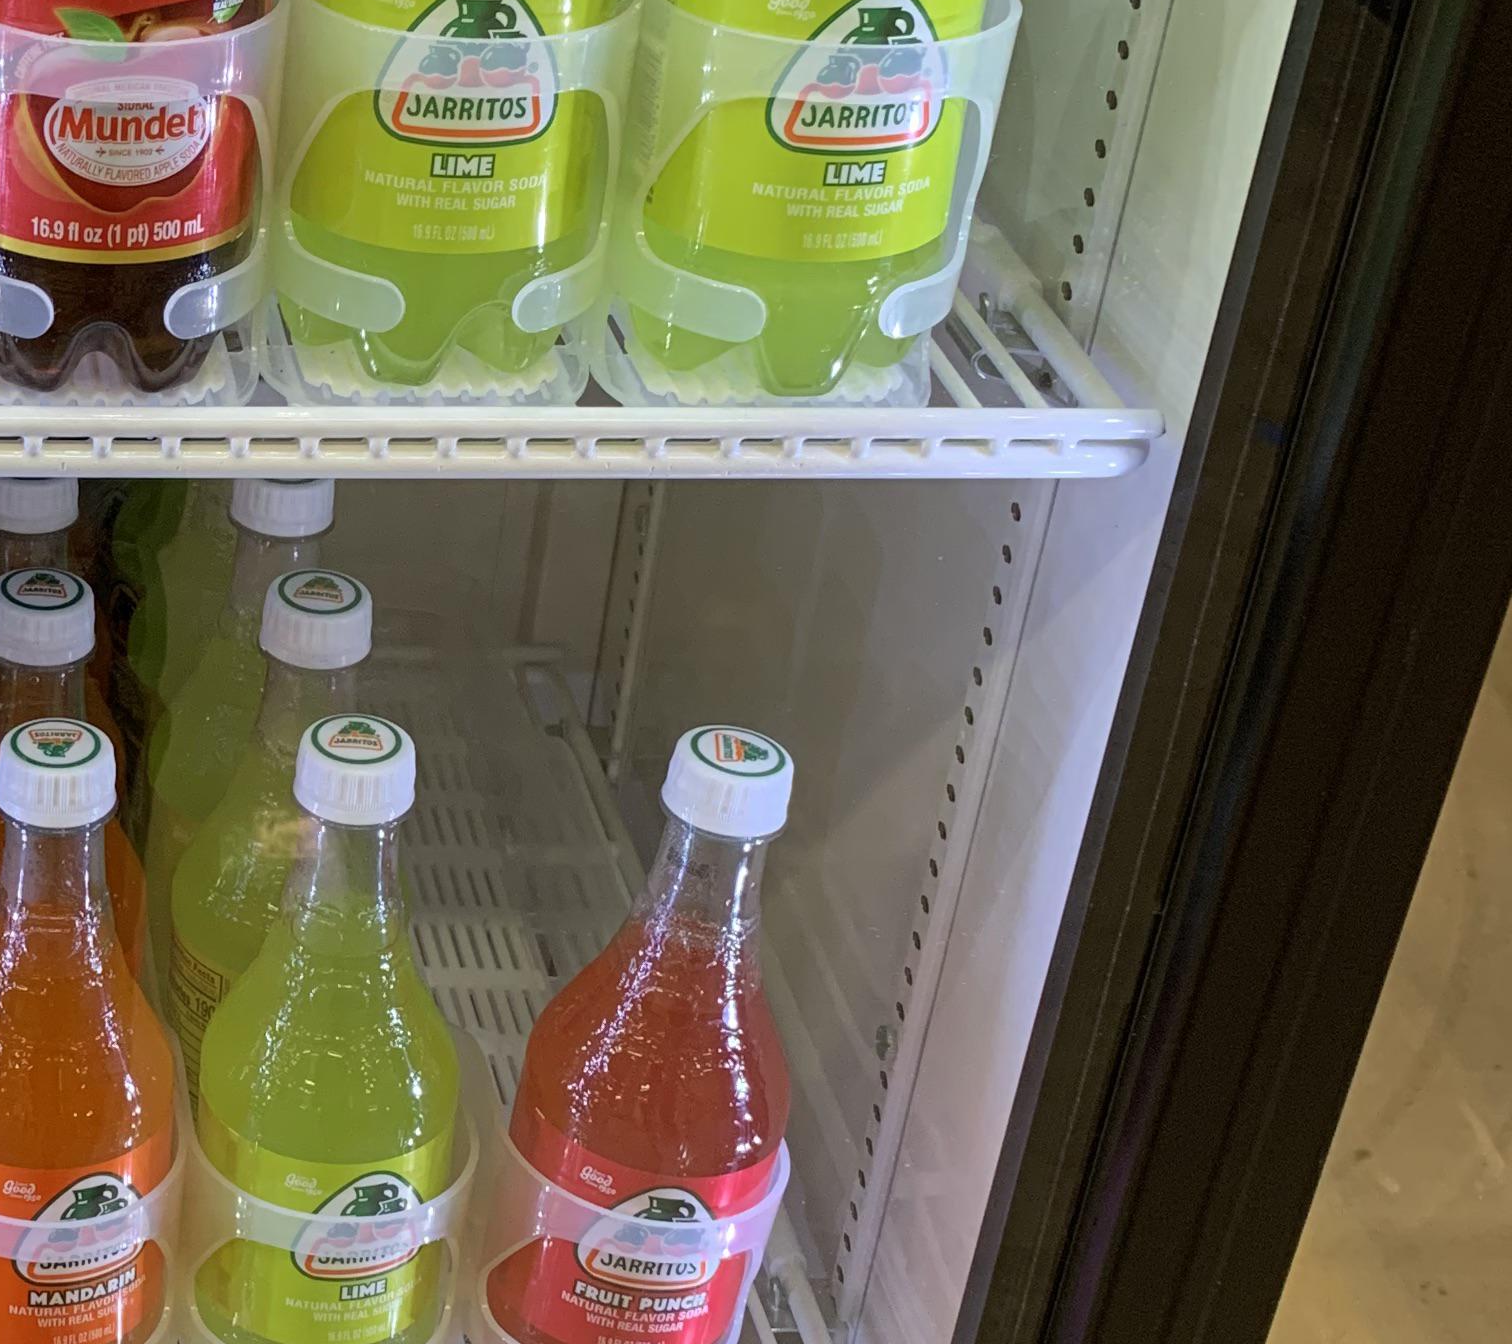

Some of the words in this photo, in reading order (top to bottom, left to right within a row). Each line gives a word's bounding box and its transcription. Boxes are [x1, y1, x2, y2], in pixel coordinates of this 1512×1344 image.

[406, 95, 527, 121] JARRITOS
[58, 104, 199, 143] Mundet
[55, 142, 104, 177] NATURALLY
[103, 167, 151, 182] FLAVORED
[153, 156, 178, 177] APPLE
[431, 154, 495, 178] LIME
[823, 160, 887, 186] LIME
[365, 168, 437, 193] NATURAL
[442, 178, 504, 194] FLAVOR
[752, 182, 828, 202] NATURAL
[834, 184, 895, 201] FLAVOR
[396, 192, 432, 209] WITH
[435, 195, 469, 211] REAL
[473, 194, 516, 210] SUGAR
[787, 202, 823, 218] WITH
[826, 203, 860, 219] REAL
[31, 217, 64, 240] 16.9
[83, 228, 102, 244] oz
[107, 225, 121, 247] (1
[127, 223, 149, 247] pt)
[153, 218, 181, 239] 500
[184, 213, 204, 236] mL
[3, 1179, 35, 1196] good
[580, 1165, 613, 1187] good
[600, 1252, 697, 1276] JARRITOS
[29, 1268, 137, 1307] MANDARIN
[340, 1279, 387, 1301] LIME
[575, 1281, 632, 1310] FRUIT
[639, 1291, 707, 1313] PUNCH
[8, 1304, 69, 1317] NATURAL
[285, 1297, 343, 1311] NATURAL
[561, 1289, 620, 1318] NATURAL
[624, 1309, 675, 1323] FLAVOR
[678, 1303, 710, 1320] SODA
[37, 1317, 66, 1328] WITH
[69, 1312, 95, 1326] REAL
[586, 1311, 614, 1331] WITH
[617, 1321, 645, 1333] REAL
[648, 1321, 685, 1333] SUGAR
